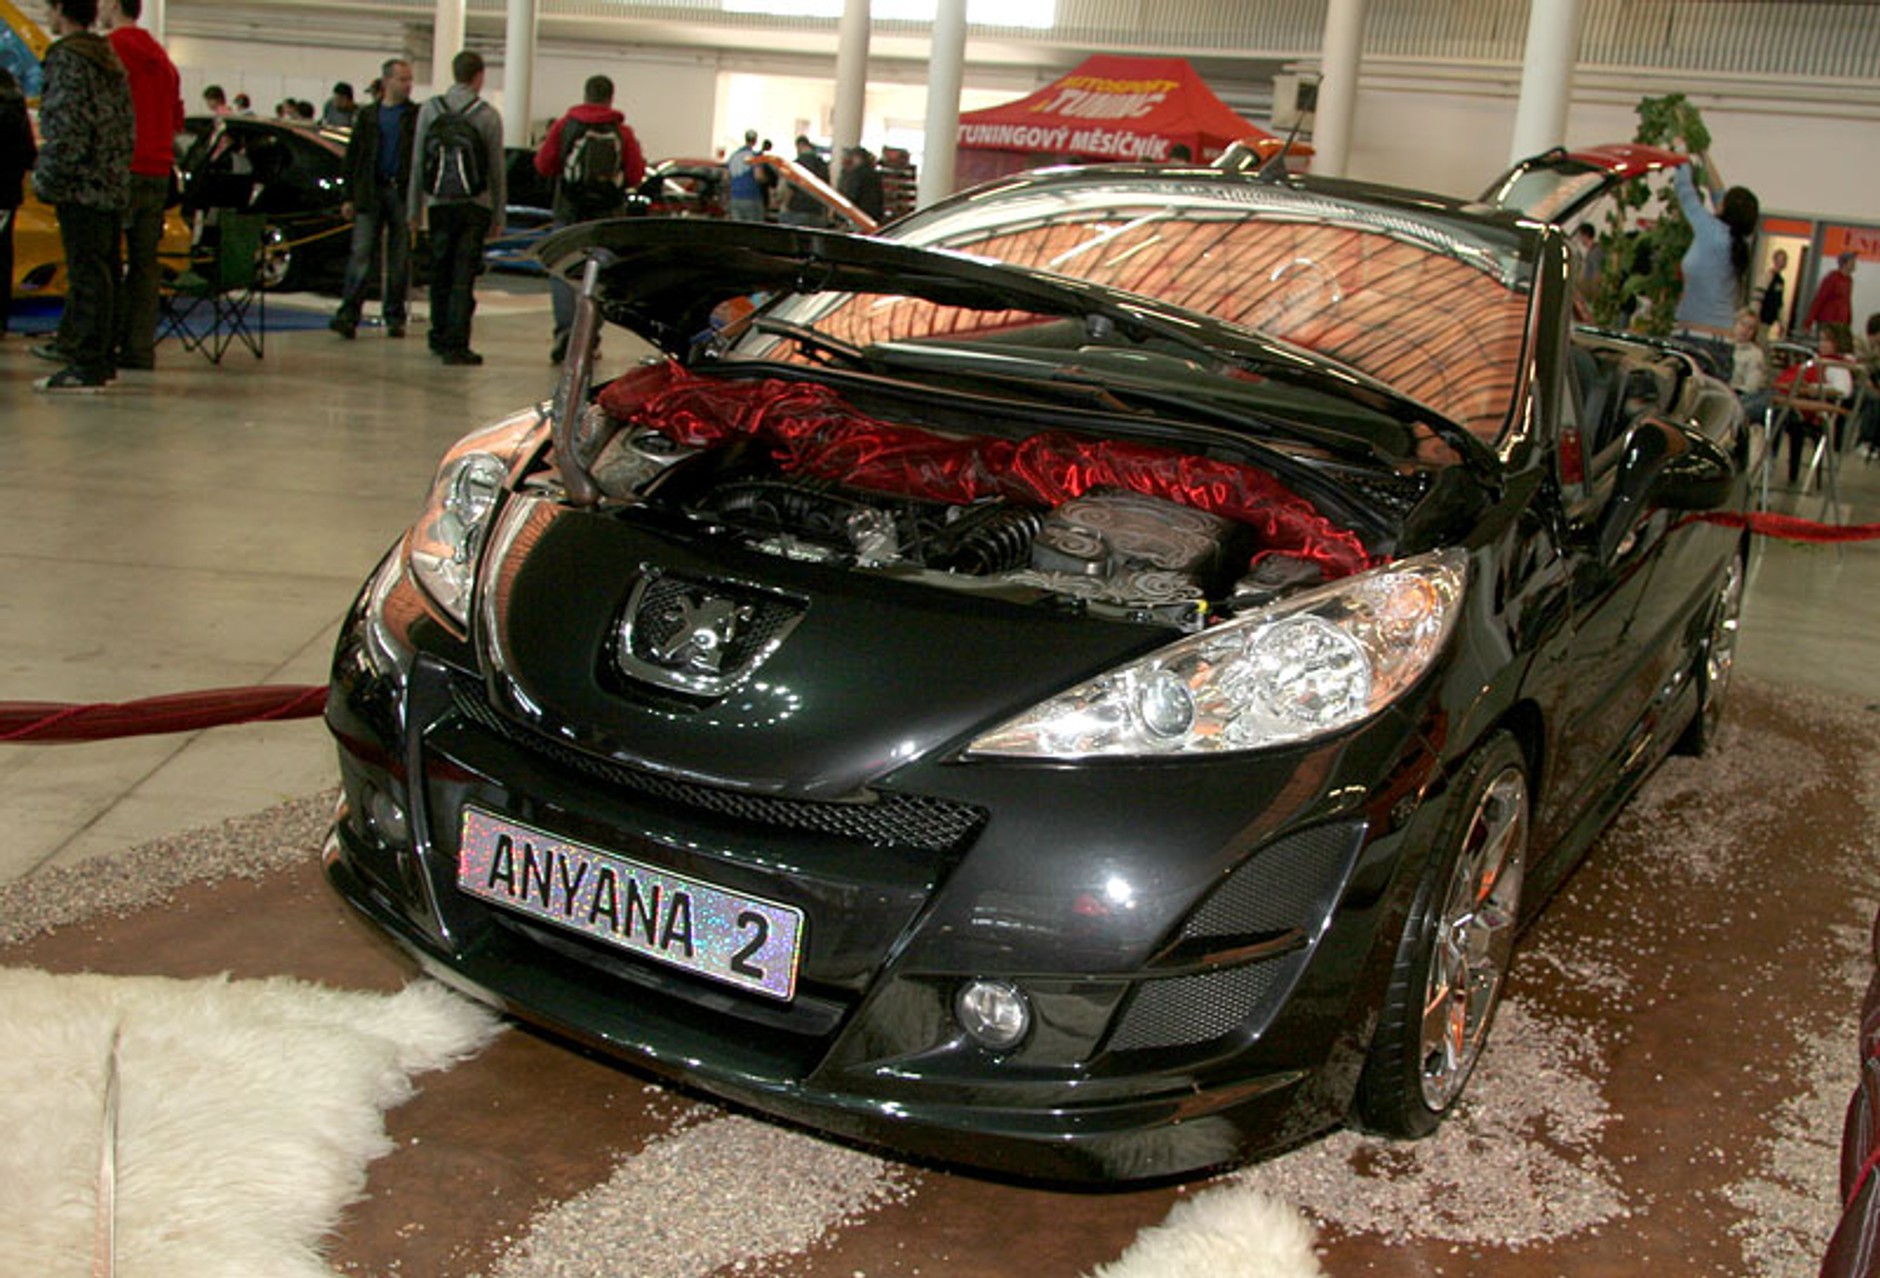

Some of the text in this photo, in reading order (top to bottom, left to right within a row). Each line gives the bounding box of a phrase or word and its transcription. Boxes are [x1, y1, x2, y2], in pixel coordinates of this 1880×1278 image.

[1070, 128, 1170, 159] MĚSÍČNÍK
[488, 833, 770, 980] ANYANA 2
